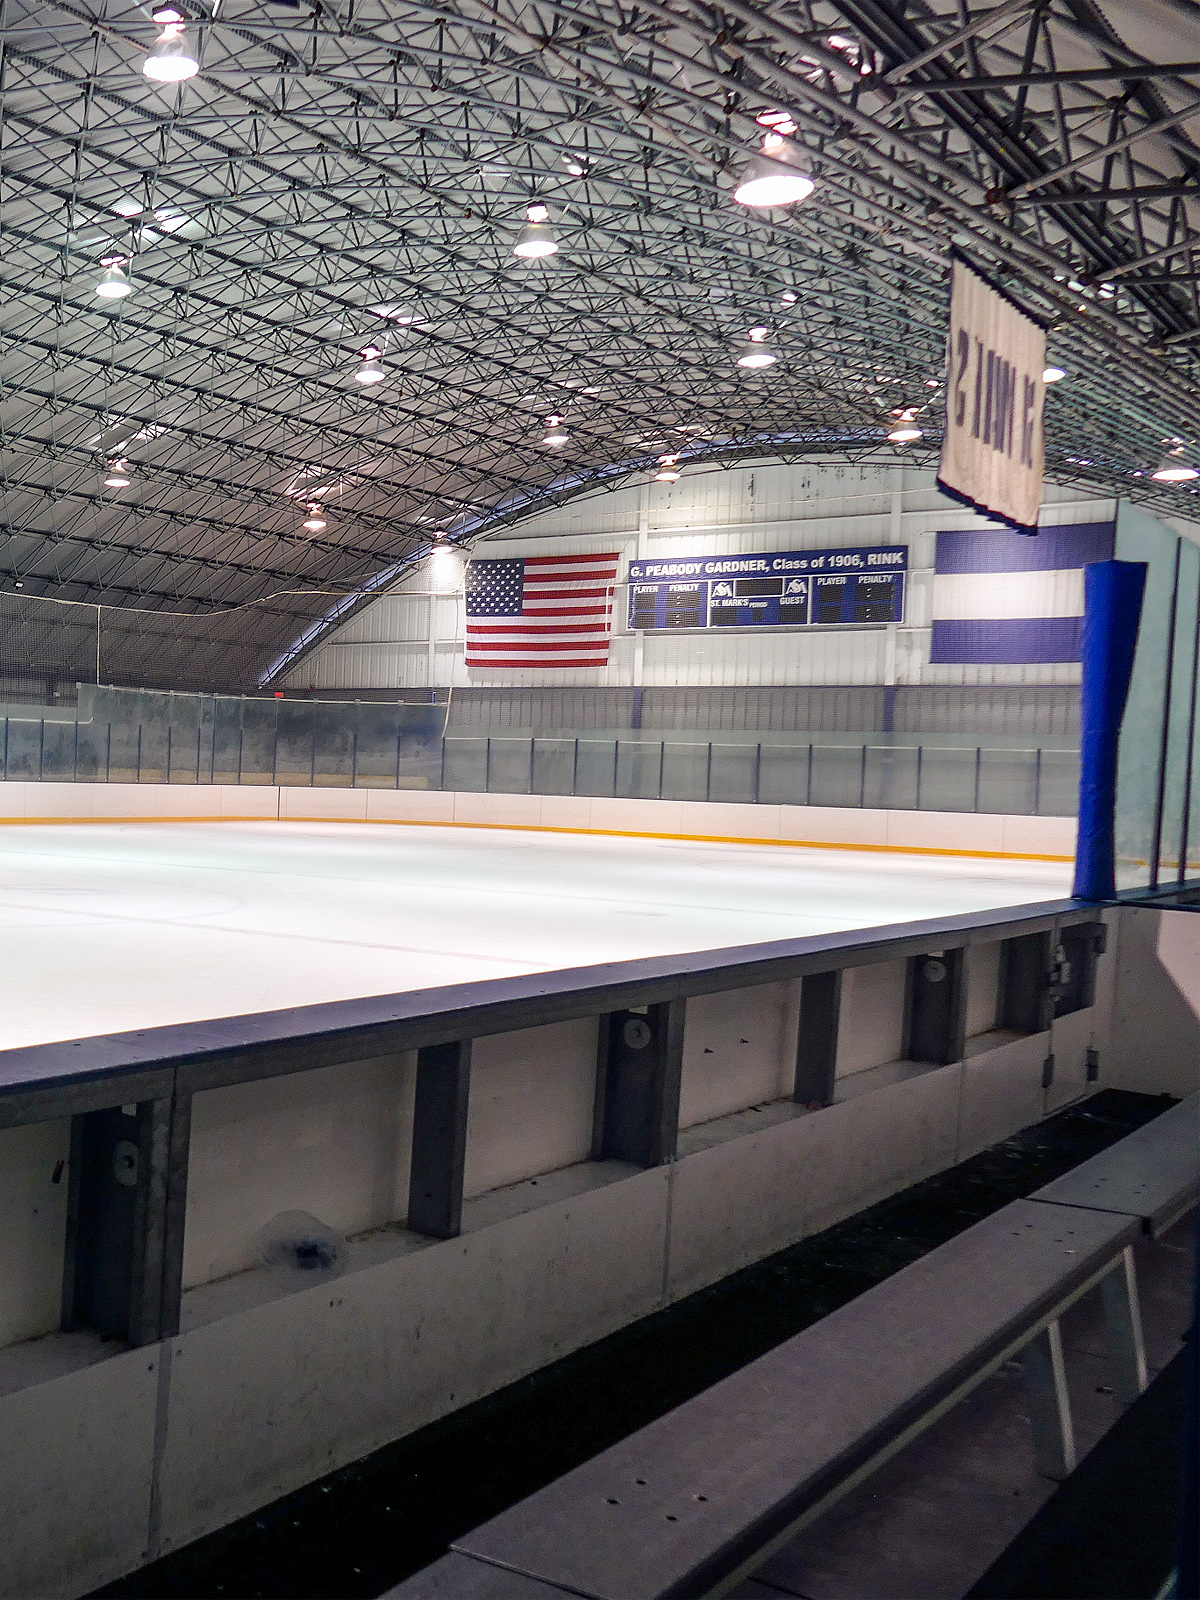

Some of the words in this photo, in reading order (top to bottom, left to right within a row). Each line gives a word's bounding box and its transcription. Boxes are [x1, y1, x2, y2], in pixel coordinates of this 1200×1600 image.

[630, 566, 644, 577] G.
[645, 562, 703, 577] PEABODY
[704, 559, 770, 573] GARDNER,
[772, 558, 809, 570] Class
[810, 556, 825, 569] of
[827, 554, 865, 568] 1906,
[867, 552, 904, 565] RINK
[817, 576, 848, 586] PLAYER
[858, 574, 894, 584] PENALTY
[633, 585, 659, 594] PLAYER
[668, 583, 700, 592] PENALTY
[721, 598, 749, 607] MARK'S
[779, 596, 806, 605] GUEST
